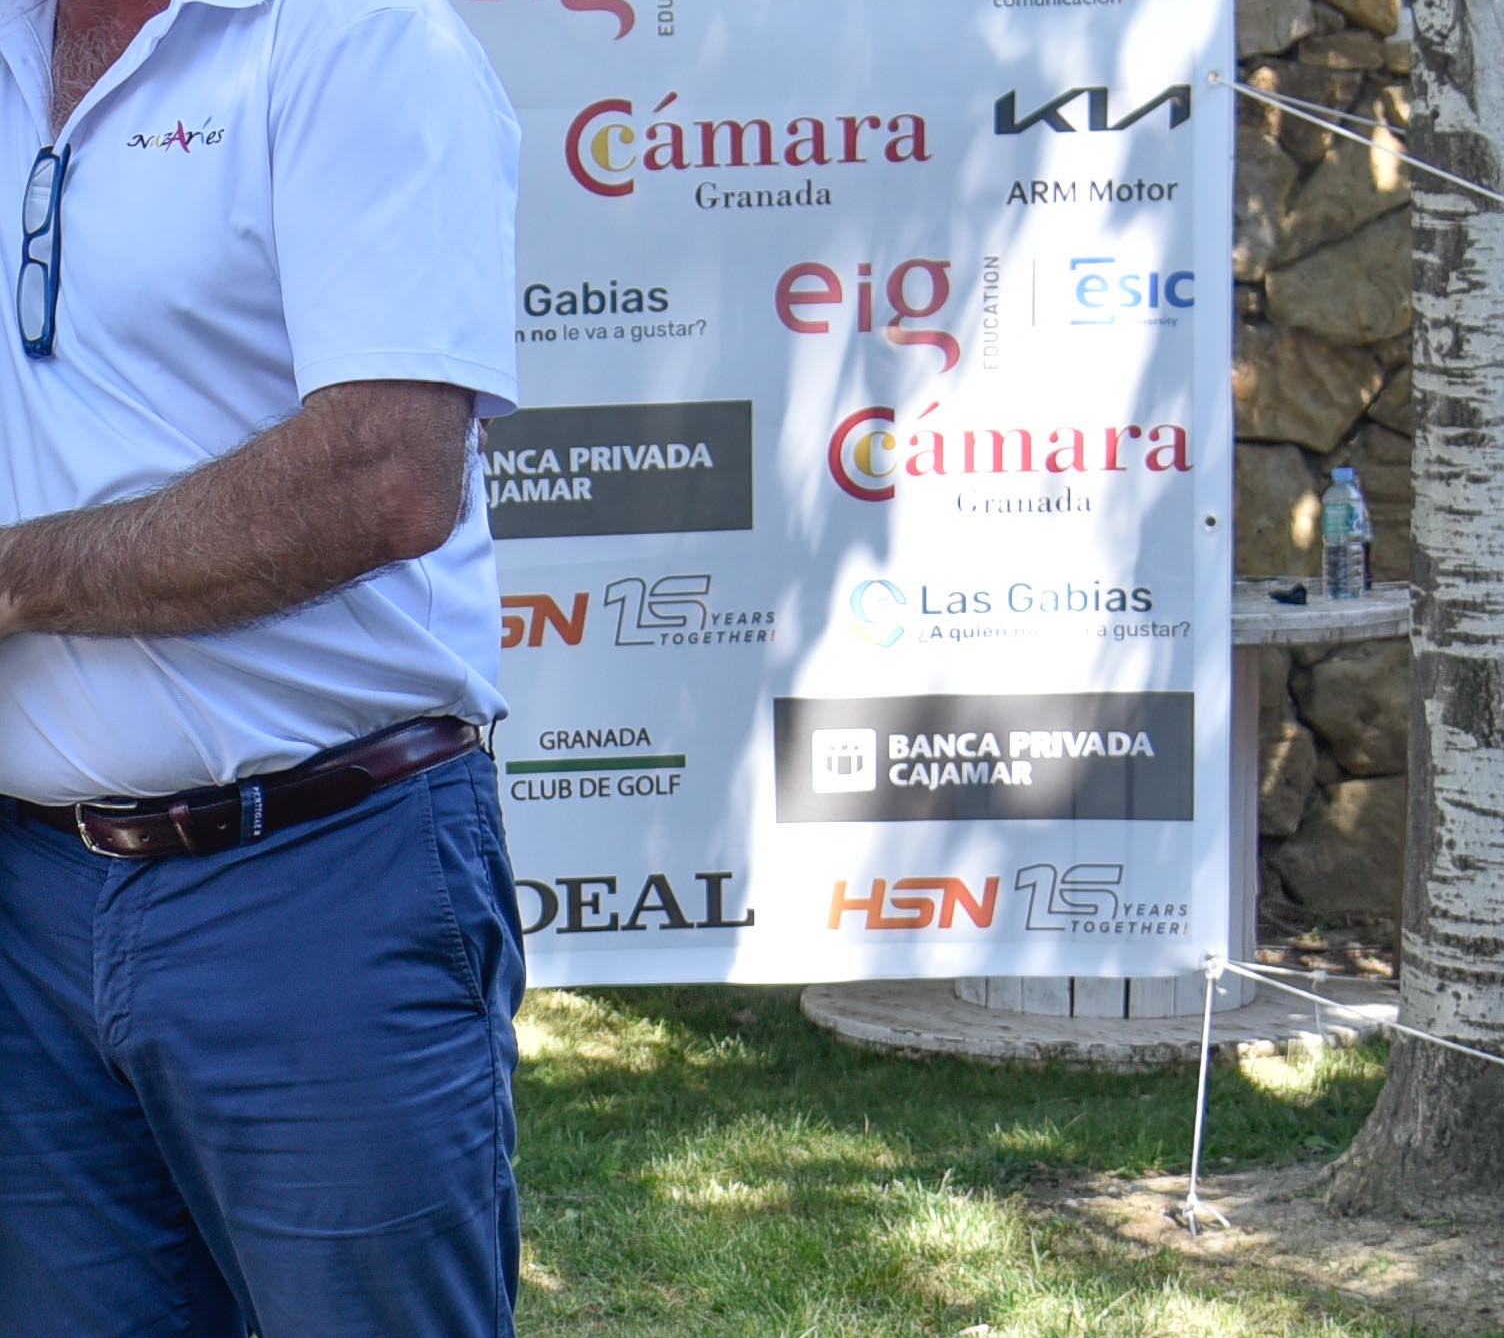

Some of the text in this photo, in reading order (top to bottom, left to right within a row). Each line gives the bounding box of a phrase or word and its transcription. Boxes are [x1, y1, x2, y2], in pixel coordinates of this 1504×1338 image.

[565, 92, 932, 198] Cámara
[694, 179, 832, 212] Granada
[1006, 177, 1179, 205] ARM Motor
[523, 280, 669, 317] Gabias
[531, 329, 557, 342] no
[563, 325, 579, 340] le
[585, 326, 607, 340] va
[614, 325, 625, 338] a
[631, 319, 707, 342] gustar?
[775, 257, 960, 373] eig
[480, 442, 714, 476] ANCA PRIVADA
[829, 401, 1194, 502] Cámara
[489, 476, 592, 508] JAMAR
[921, 580, 1153, 615] Las Gabias
[711, 610, 775, 626] YEARS
[1113, 621, 1191, 642] gustar?
[660, 629, 775, 645] TOGETHER!
[539, 727, 651, 751] GRANADA
[889, 730, 1154, 760] BANCA PRIVADA
[511, 774, 681, 801] CLUB DE GOLF
[889, 761, 1032, 791] CAJAMAR
[513, 871, 754, 935] DEAL
[827, 876, 1000, 930] HSN
[1122, 902, 1188, 918] YEARS
